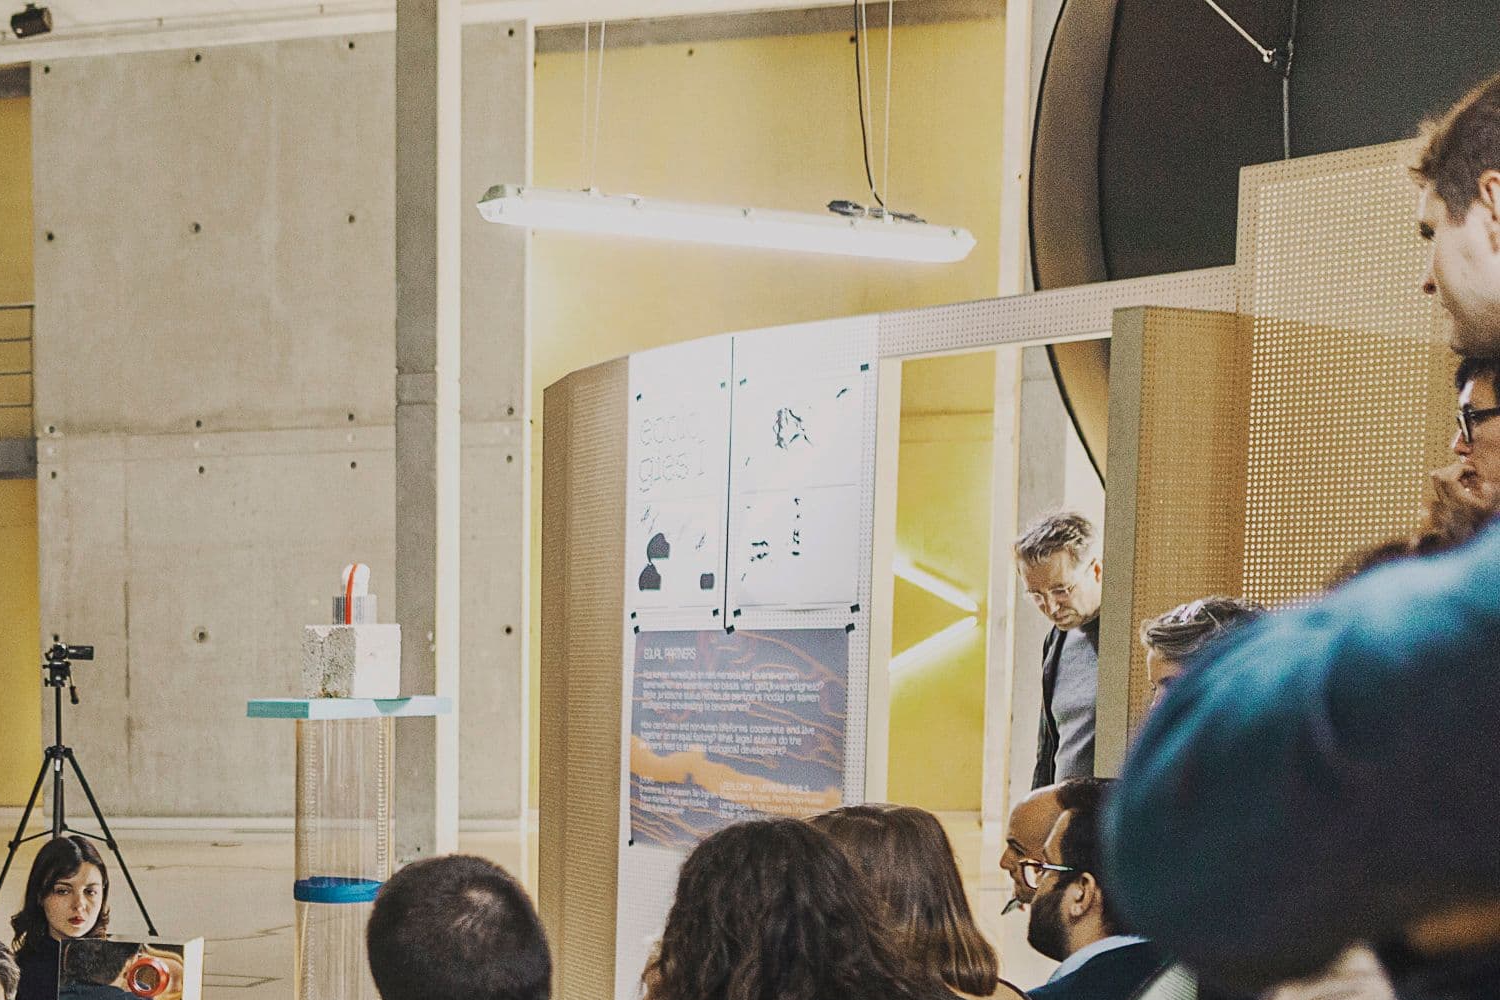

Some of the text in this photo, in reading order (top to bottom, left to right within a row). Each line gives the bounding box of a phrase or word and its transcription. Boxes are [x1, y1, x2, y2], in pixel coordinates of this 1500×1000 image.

[664, 648, 697, 660] PARTNERS
[731, 693, 762, 702] partners
[763, 692, 785, 704] nodig
[750, 724, 784, 734] cooperate
[786, 725, 800, 735] and
[735, 734, 752, 746] legal
[778, 736, 788, 745] do
[789, 737, 802, 746] the
